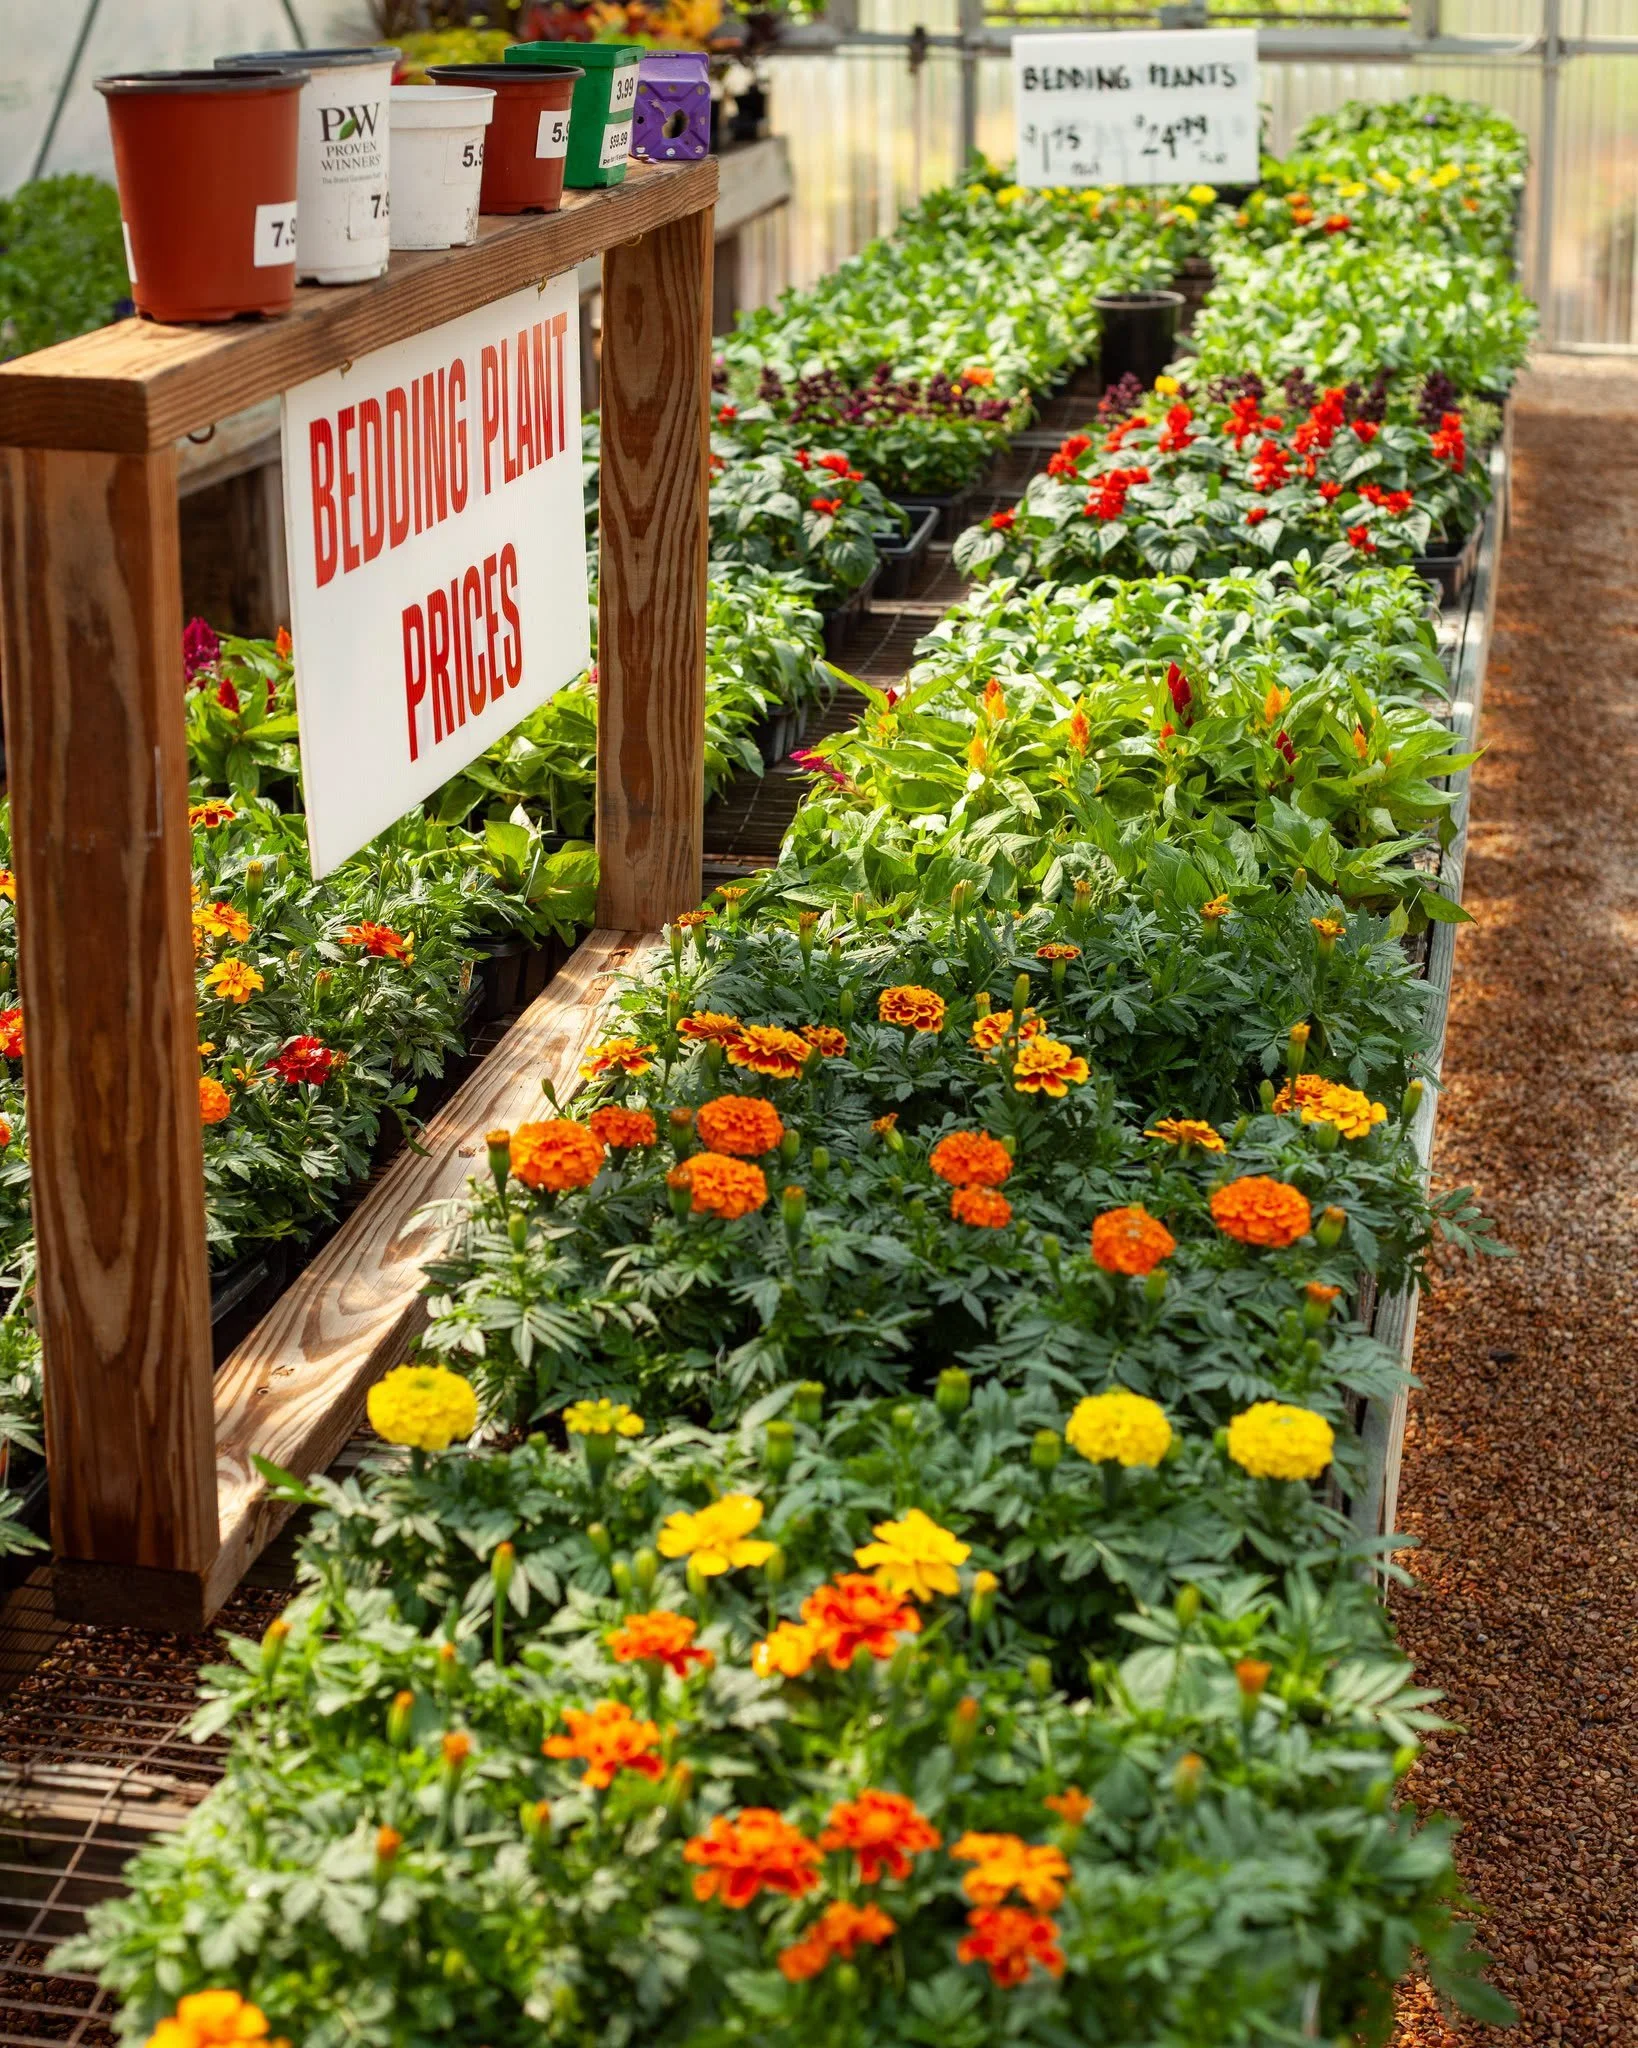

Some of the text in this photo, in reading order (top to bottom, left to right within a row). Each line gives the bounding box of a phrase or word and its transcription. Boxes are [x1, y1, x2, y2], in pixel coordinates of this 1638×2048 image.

[616, 77, 634, 100] 3.99
[1022, 62, 1237, 91] BEDDING PLANTS
[326, 141, 377, 158] PROVEN
[321, 155, 380, 171] WINNERS
[309, 311, 568, 589] BEDDING PLANT
[402, 542, 523, 763] PRICES
